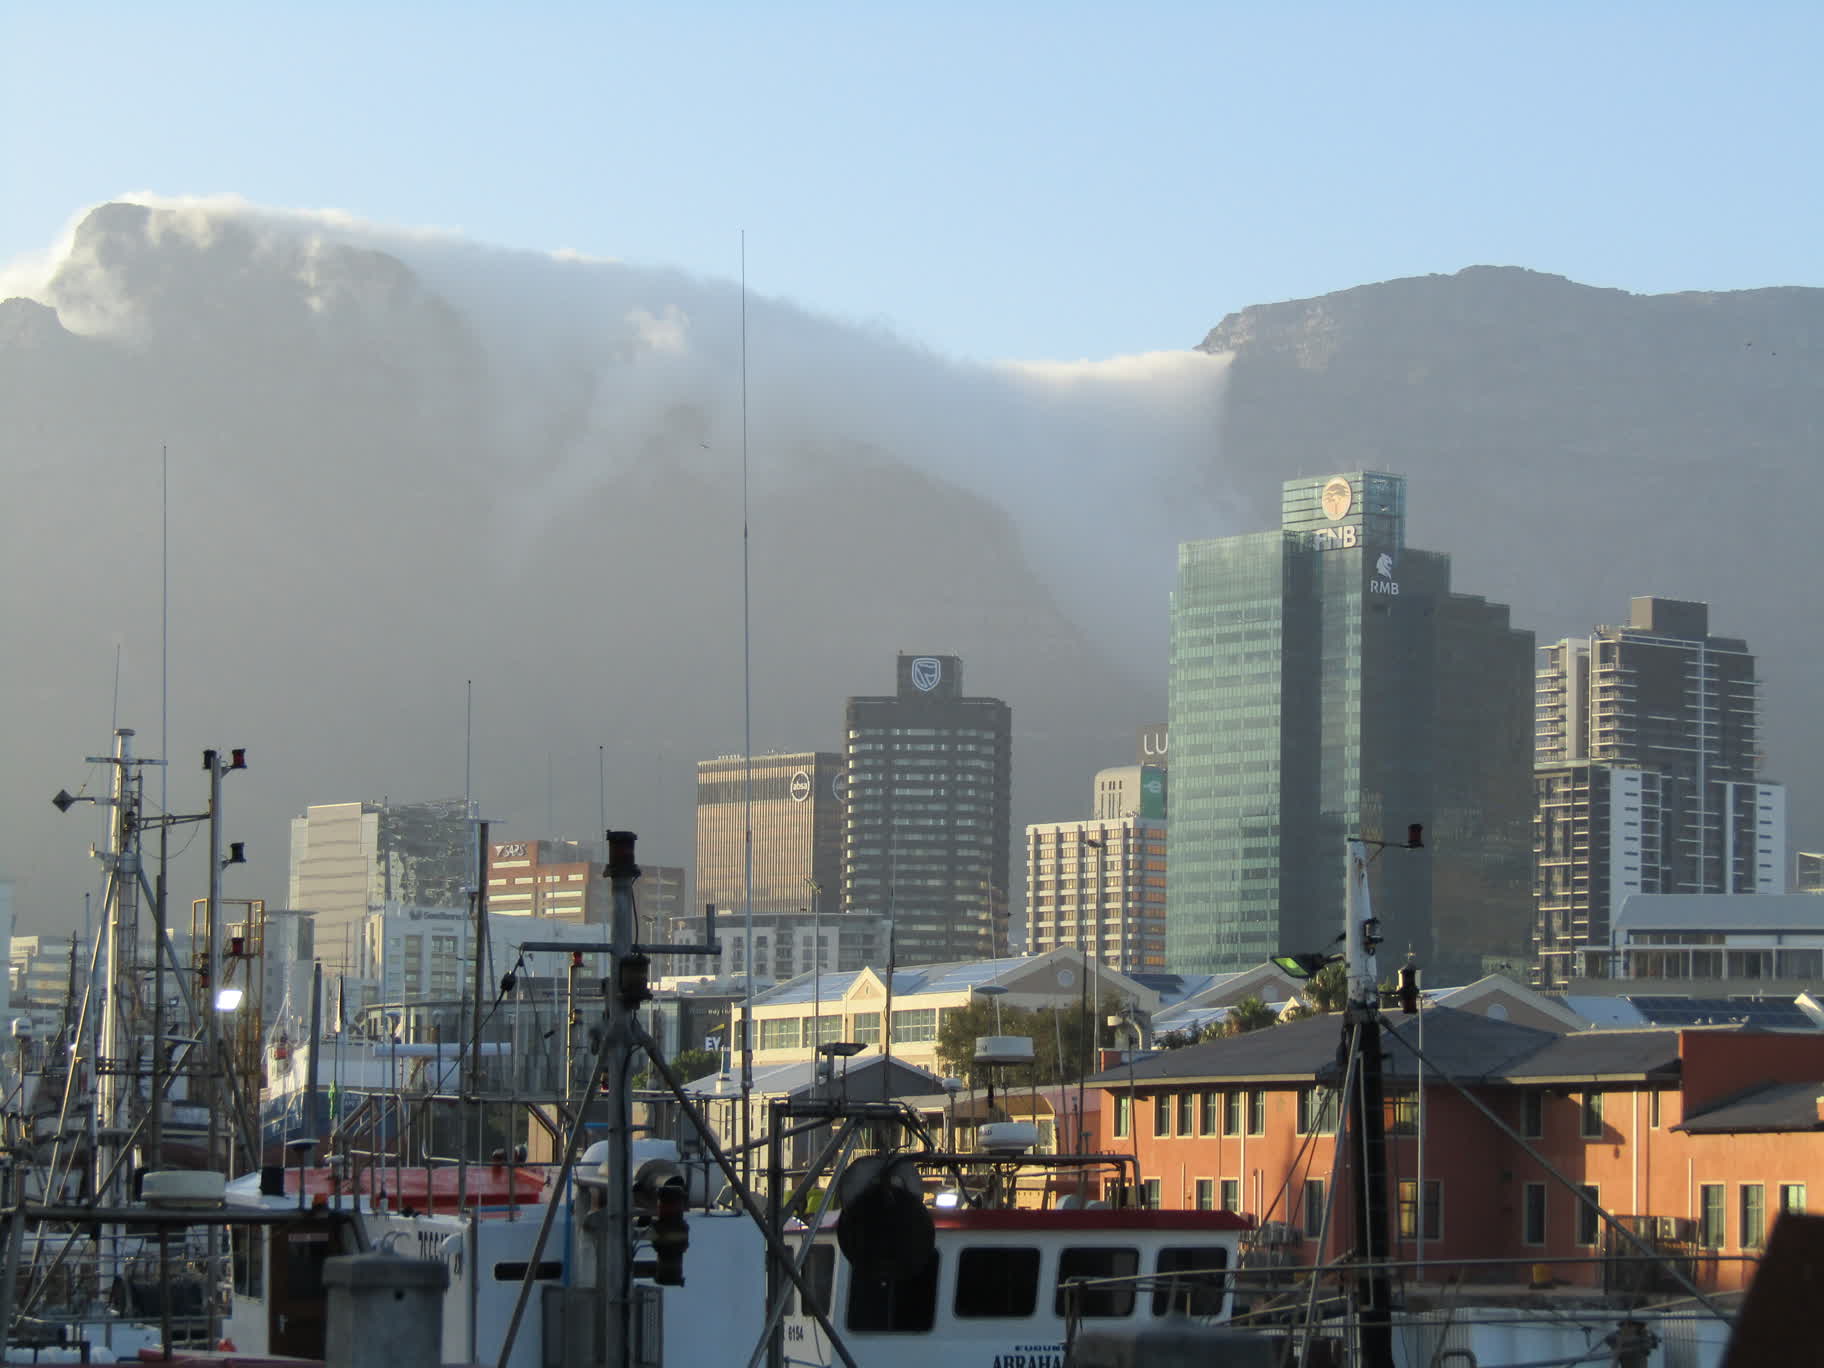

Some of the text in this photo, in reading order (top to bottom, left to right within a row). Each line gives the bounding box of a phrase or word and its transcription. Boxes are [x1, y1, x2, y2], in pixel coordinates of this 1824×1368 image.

[1313, 525, 1357, 551] FNB
[1369, 580, 1400, 596] RMB
[704, 1036, 721, 1052] EY
[993, 1354, 1066, 1368] ABRAHA
